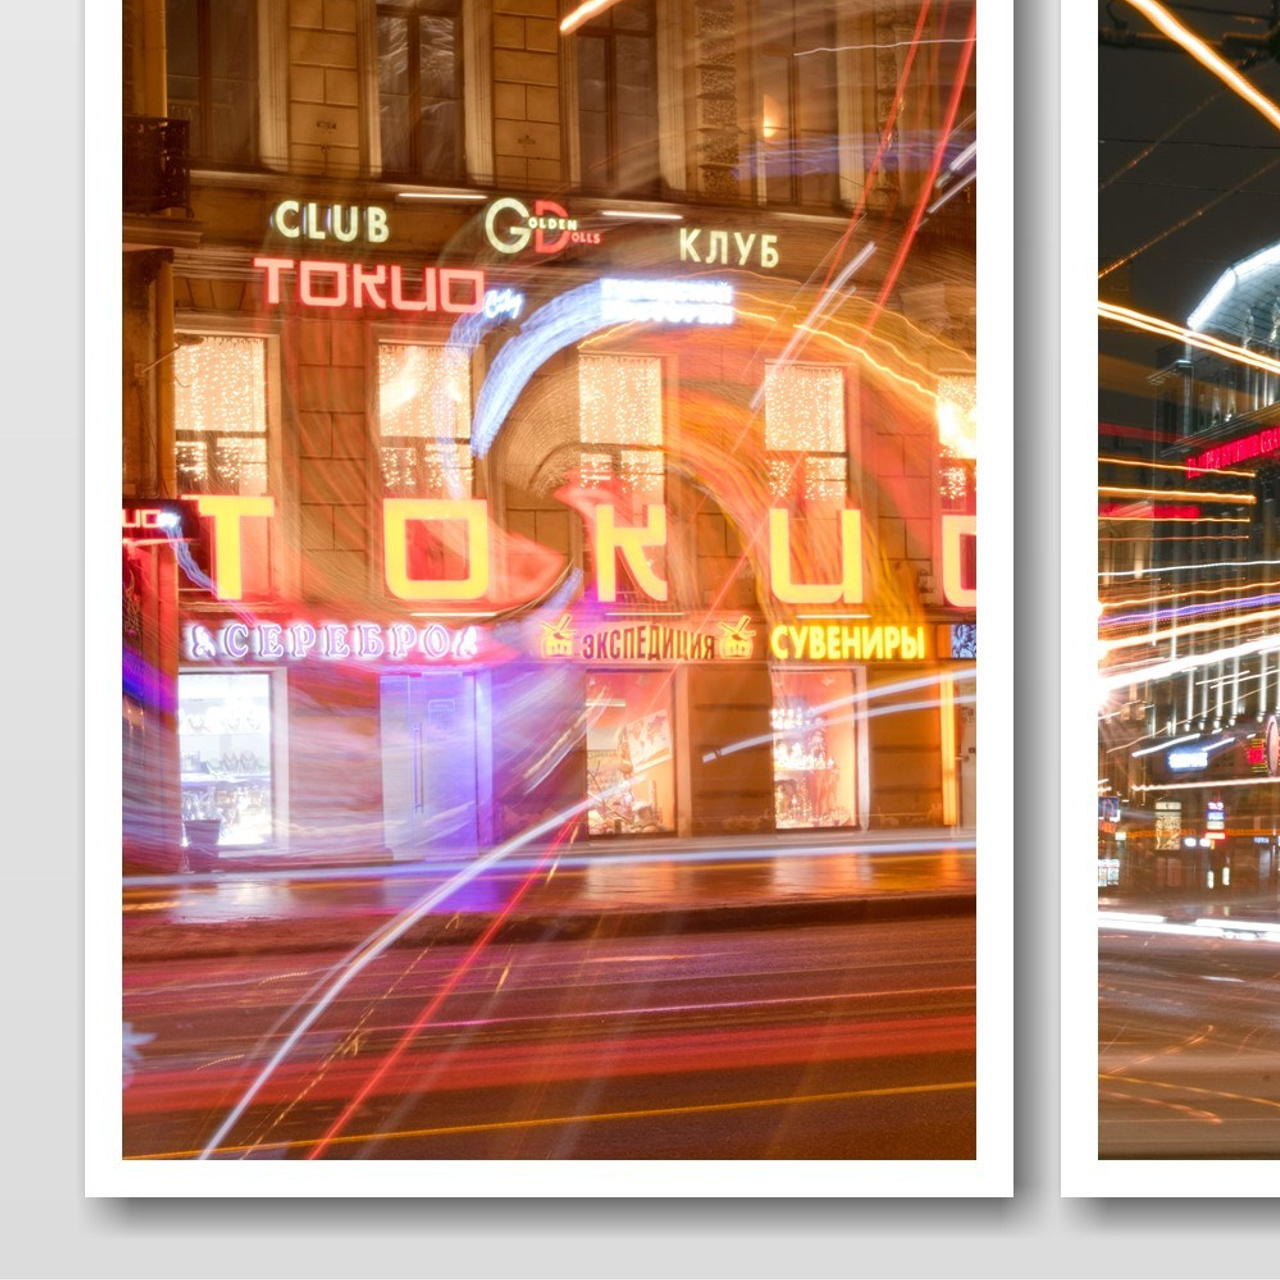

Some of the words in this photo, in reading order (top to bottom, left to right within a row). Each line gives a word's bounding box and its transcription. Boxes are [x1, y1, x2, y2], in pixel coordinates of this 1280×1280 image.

[274, 200, 390, 243] CLUB
[679, 227, 779, 268] КЛУБ
[223, 623, 450, 659] СЕРЕБРО
[582, 623, 716, 661] ЭКСПЕДИЦИЯ
[770, 623, 926, 660] СУВЕНИРЫ
